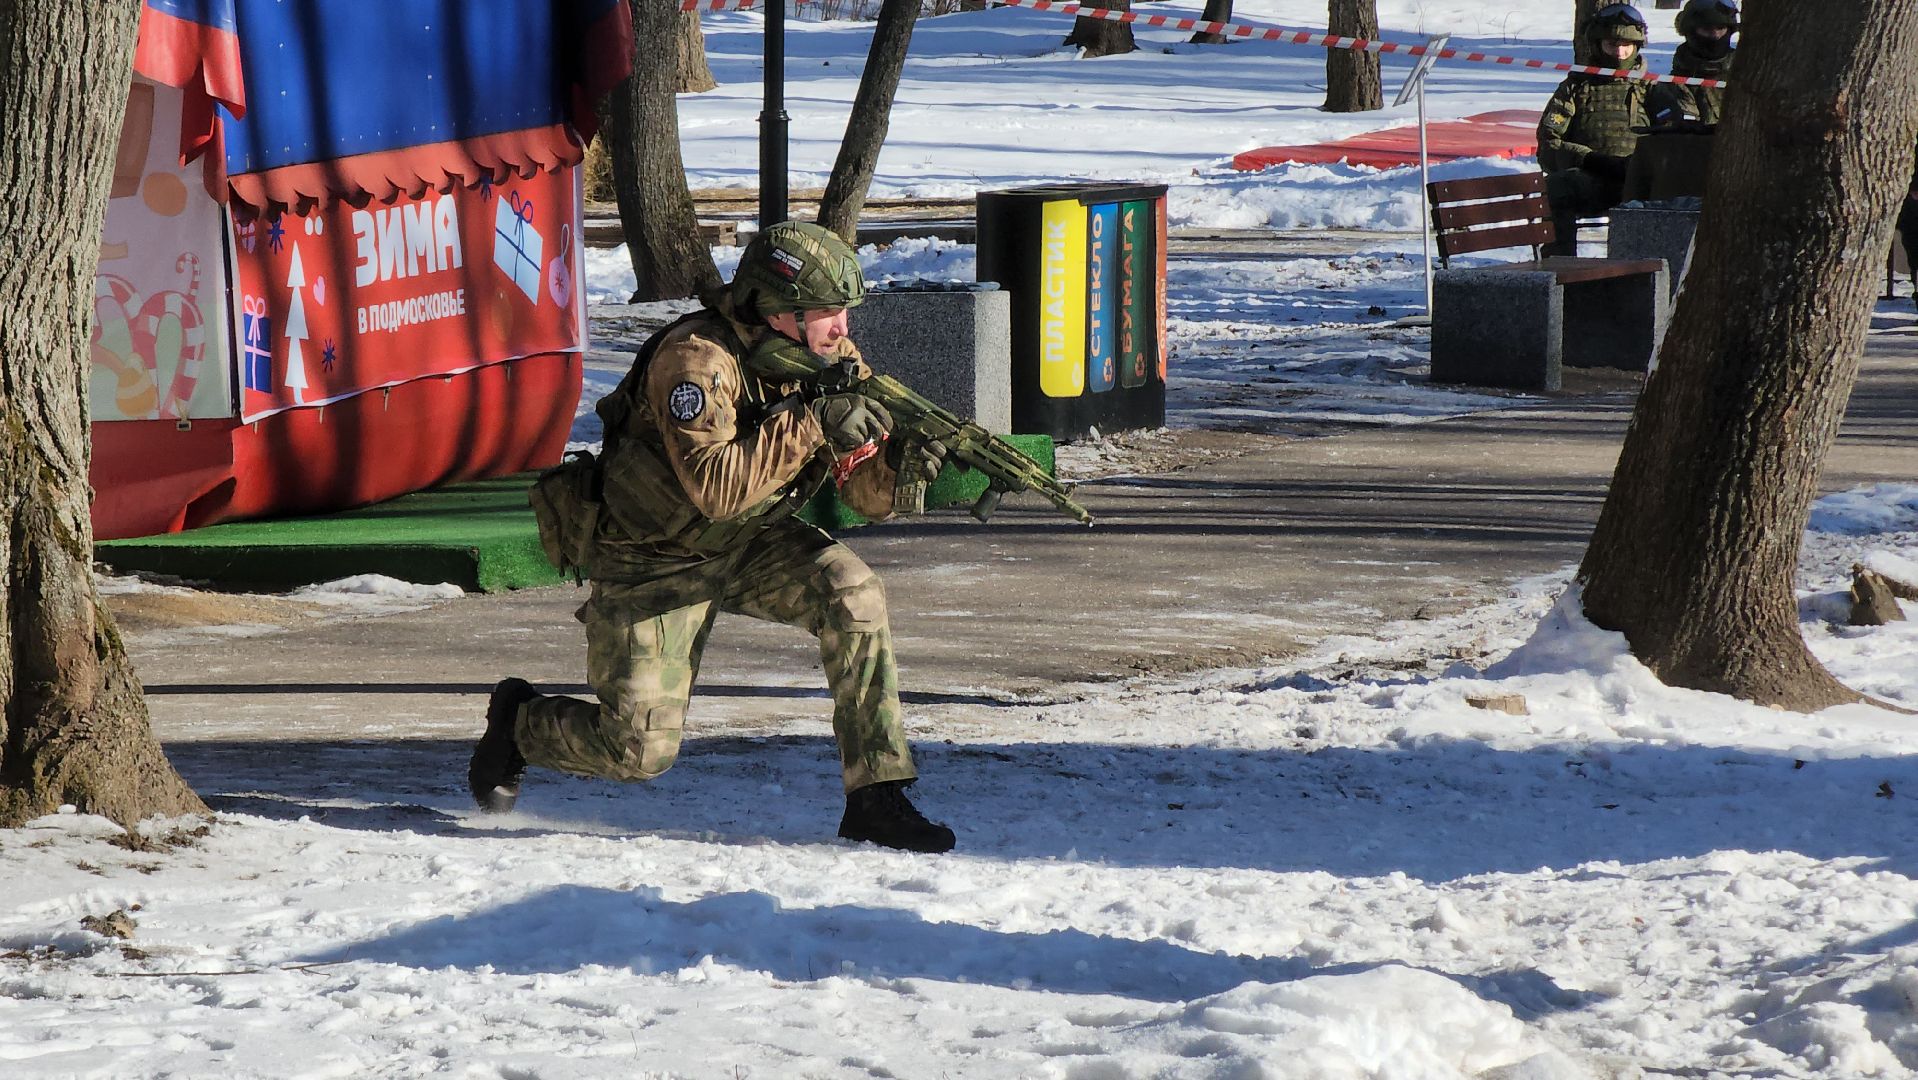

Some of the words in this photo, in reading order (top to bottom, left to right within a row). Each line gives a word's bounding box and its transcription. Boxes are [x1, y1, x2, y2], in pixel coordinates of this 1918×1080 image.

[352, 194, 463, 288] ЗИМА
[358, 305, 368, 334] В
[369, 289, 466, 333] ПОДМОСКОВЬЕ
[1045, 220, 1066, 361] ПЛАСТИК
[1090, 212, 1103, 357] СТЕКЛО
[1122, 208, 1135, 353] БУМАГА
